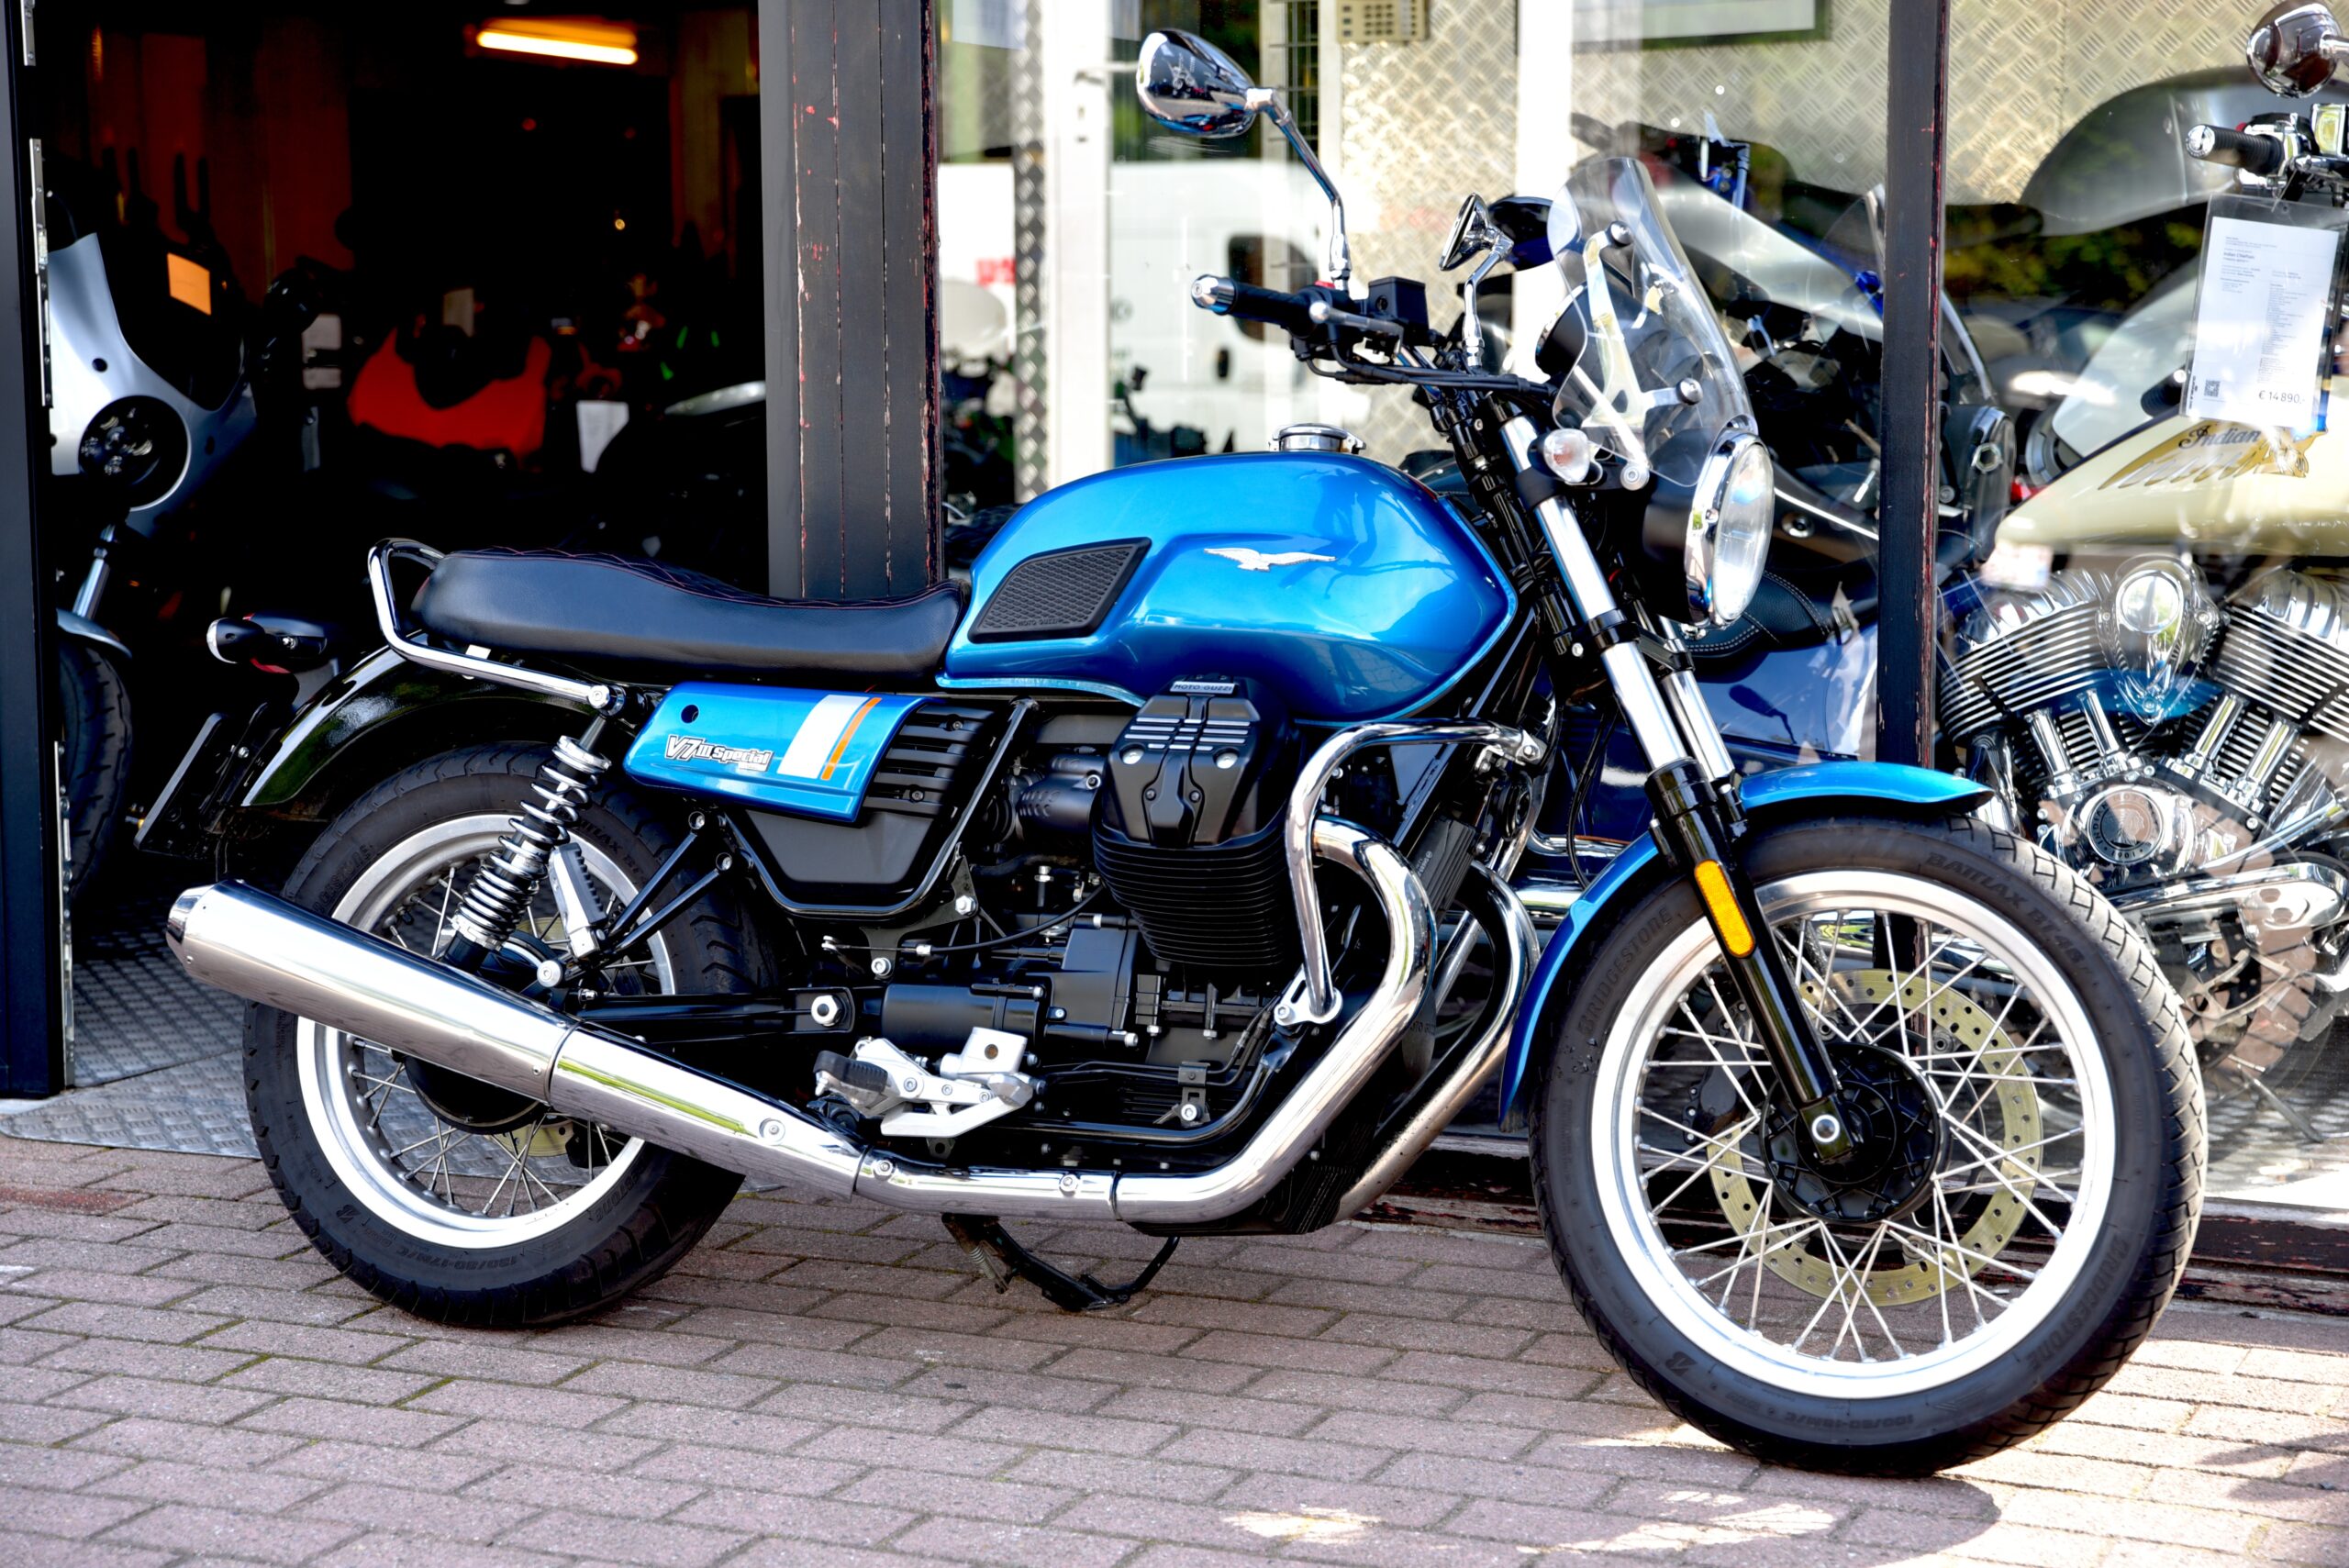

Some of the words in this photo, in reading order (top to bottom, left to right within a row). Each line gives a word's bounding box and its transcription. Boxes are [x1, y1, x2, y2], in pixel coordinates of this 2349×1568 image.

[2178, 425, 2261, 449] Indian
[666, 735, 704, 760] V7
[712, 745, 772, 764] Special
[1926, 852, 2025, 908] BATTLAX
[1578, 904, 1673, 1035] BRIDGESTONE
